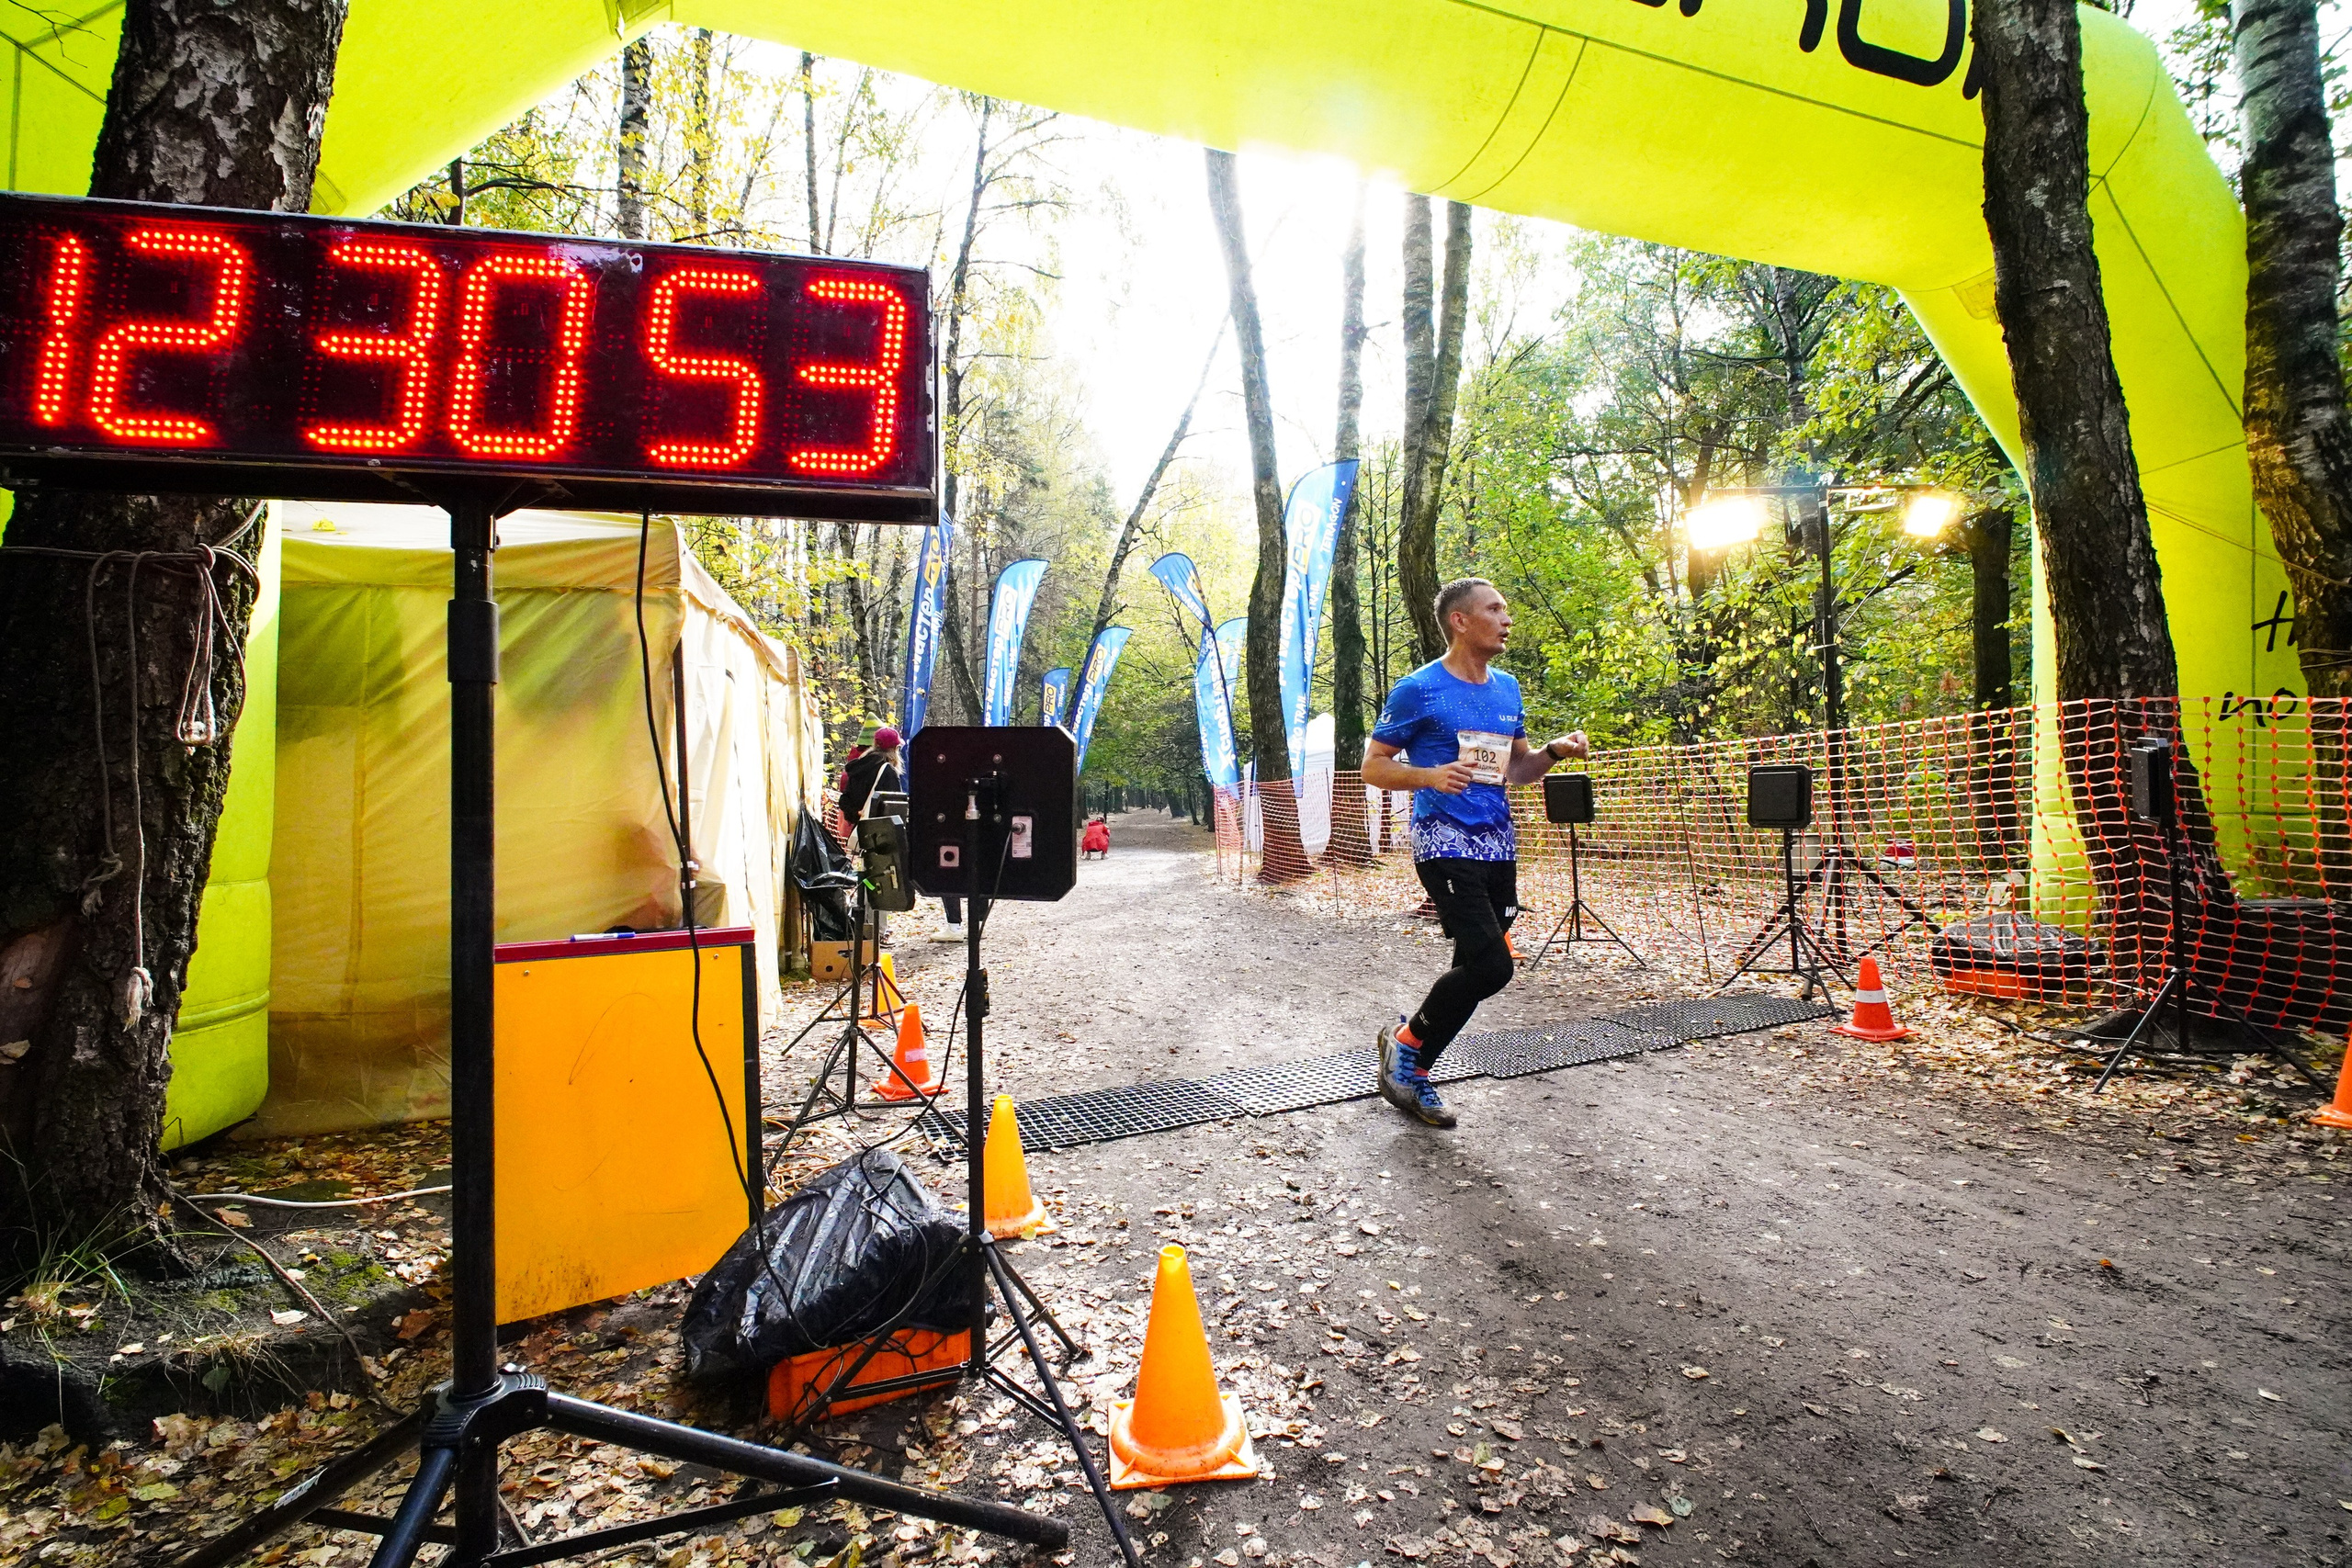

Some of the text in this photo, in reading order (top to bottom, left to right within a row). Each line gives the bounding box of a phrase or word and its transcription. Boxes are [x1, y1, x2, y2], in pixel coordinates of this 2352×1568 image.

[35, 230, 907, 474] 12 30 53
[1292, 507, 1315, 569] PRO
[1309, 581, 1320, 611] TRAIL
[1319, 497, 1343, 553] TETRAGON
[997, 590, 1015, 636] PRO
[1089, 649, 1105, 683] PRO
[1045, 686, 1055, 714] PRO
[1474, 749, 1497, 764] 102
[1477, 763, 1500, 773] адимир
